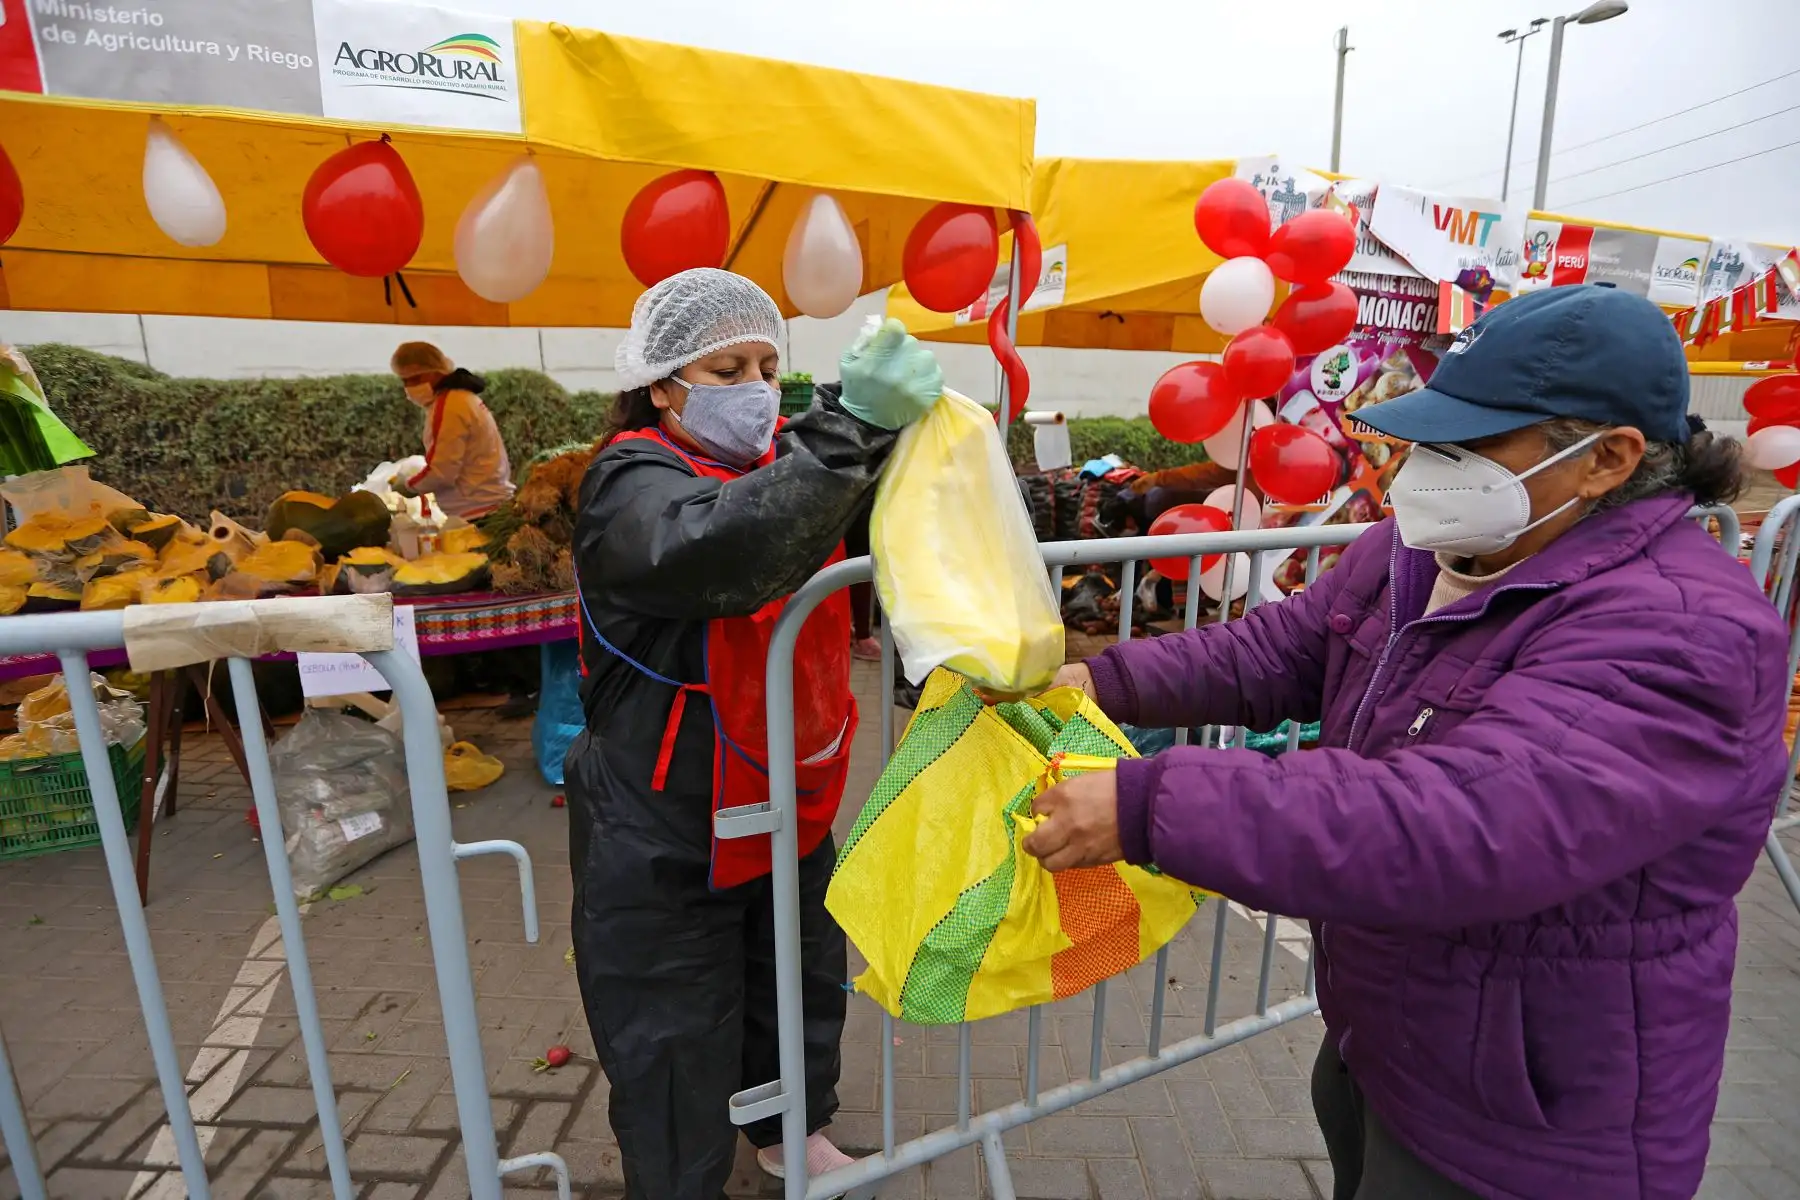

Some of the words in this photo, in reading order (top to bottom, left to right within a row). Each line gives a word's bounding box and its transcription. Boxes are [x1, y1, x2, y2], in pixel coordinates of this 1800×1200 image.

[36, 0, 164, 27] Ministerio
[41, 25, 76, 44] de
[84, 28, 221, 56] Agricultura
[226, 44, 240, 62] y
[247, 44, 314, 69] Riego
[332, 68, 374, 79] PROGRAMA
[380, 74, 421, 85] DESARROLLO
[422, 79, 460, 89] PRODUCTIVO
[460, 83, 487, 91] AGRARIO
[487, 84, 508, 92] RURAL
[1432, 204, 1502, 248] VMT
[1557, 254, 1585, 269] PERÚ
